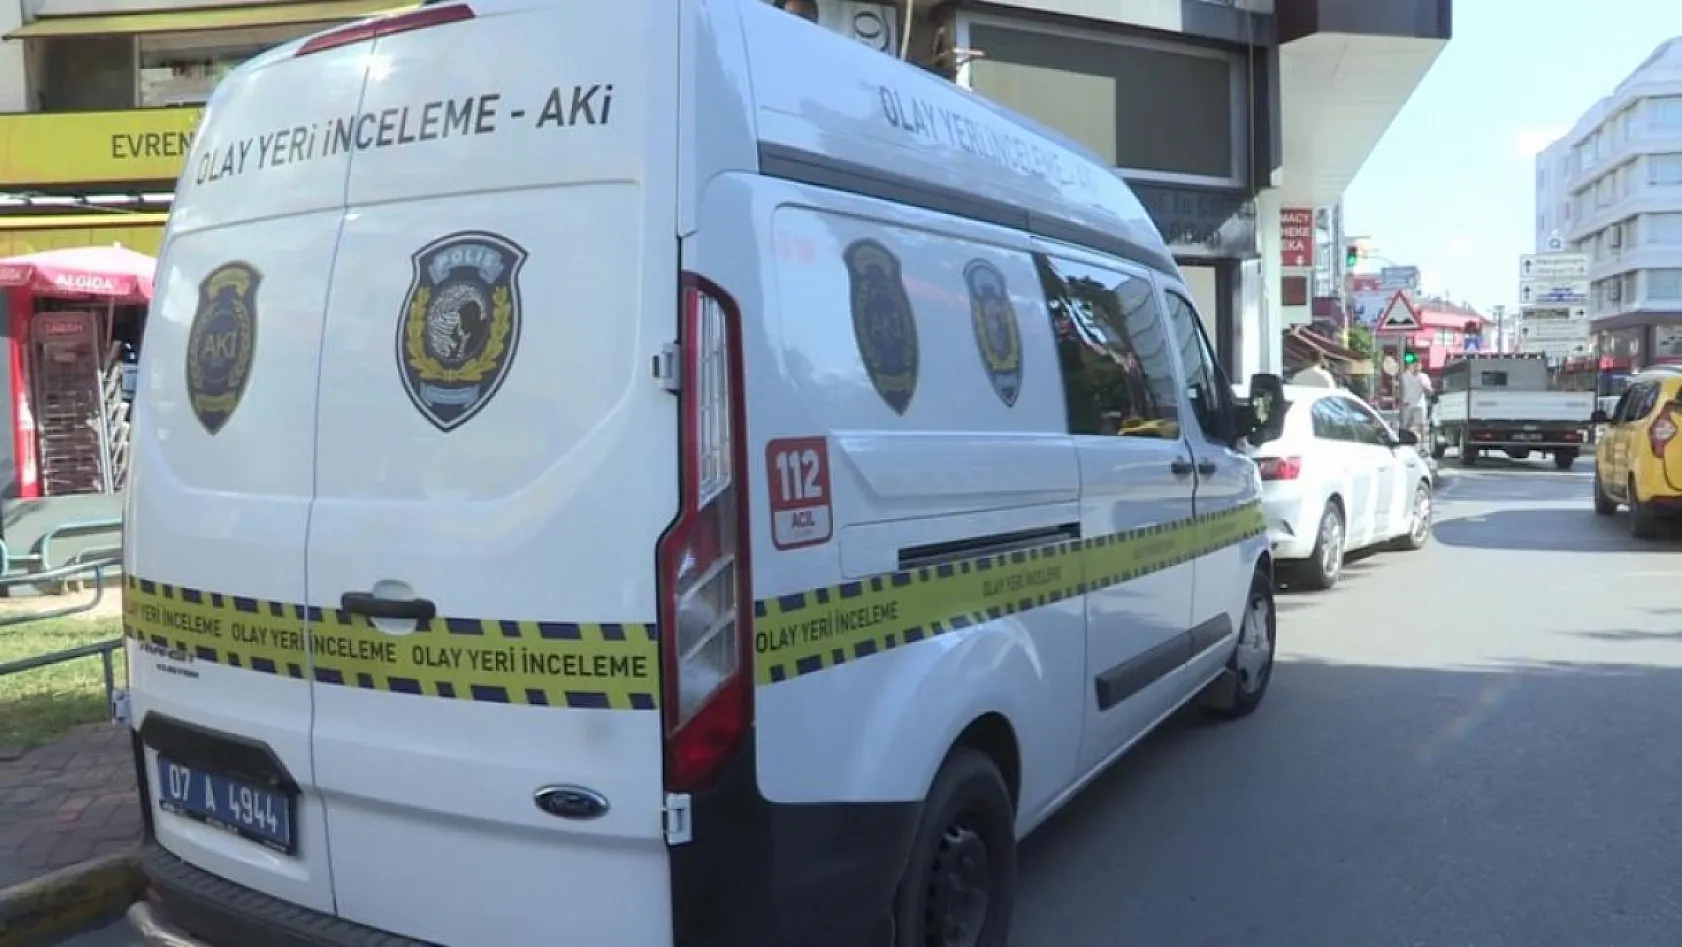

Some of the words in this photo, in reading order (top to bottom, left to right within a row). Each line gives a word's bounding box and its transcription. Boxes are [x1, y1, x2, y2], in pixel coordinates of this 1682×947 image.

[111, 130, 197, 159] EVREN
[196, 137, 254, 185] OLAY
[776, 449, 822, 501] 112
[231, 623, 268, 645] OLAY
[756, 624, 796, 653] OLAY
[412, 645, 462, 669] OLAY
[168, 764, 191, 801] 07
[205, 774, 216, 812] A
[228, 783, 278, 834] 4944
